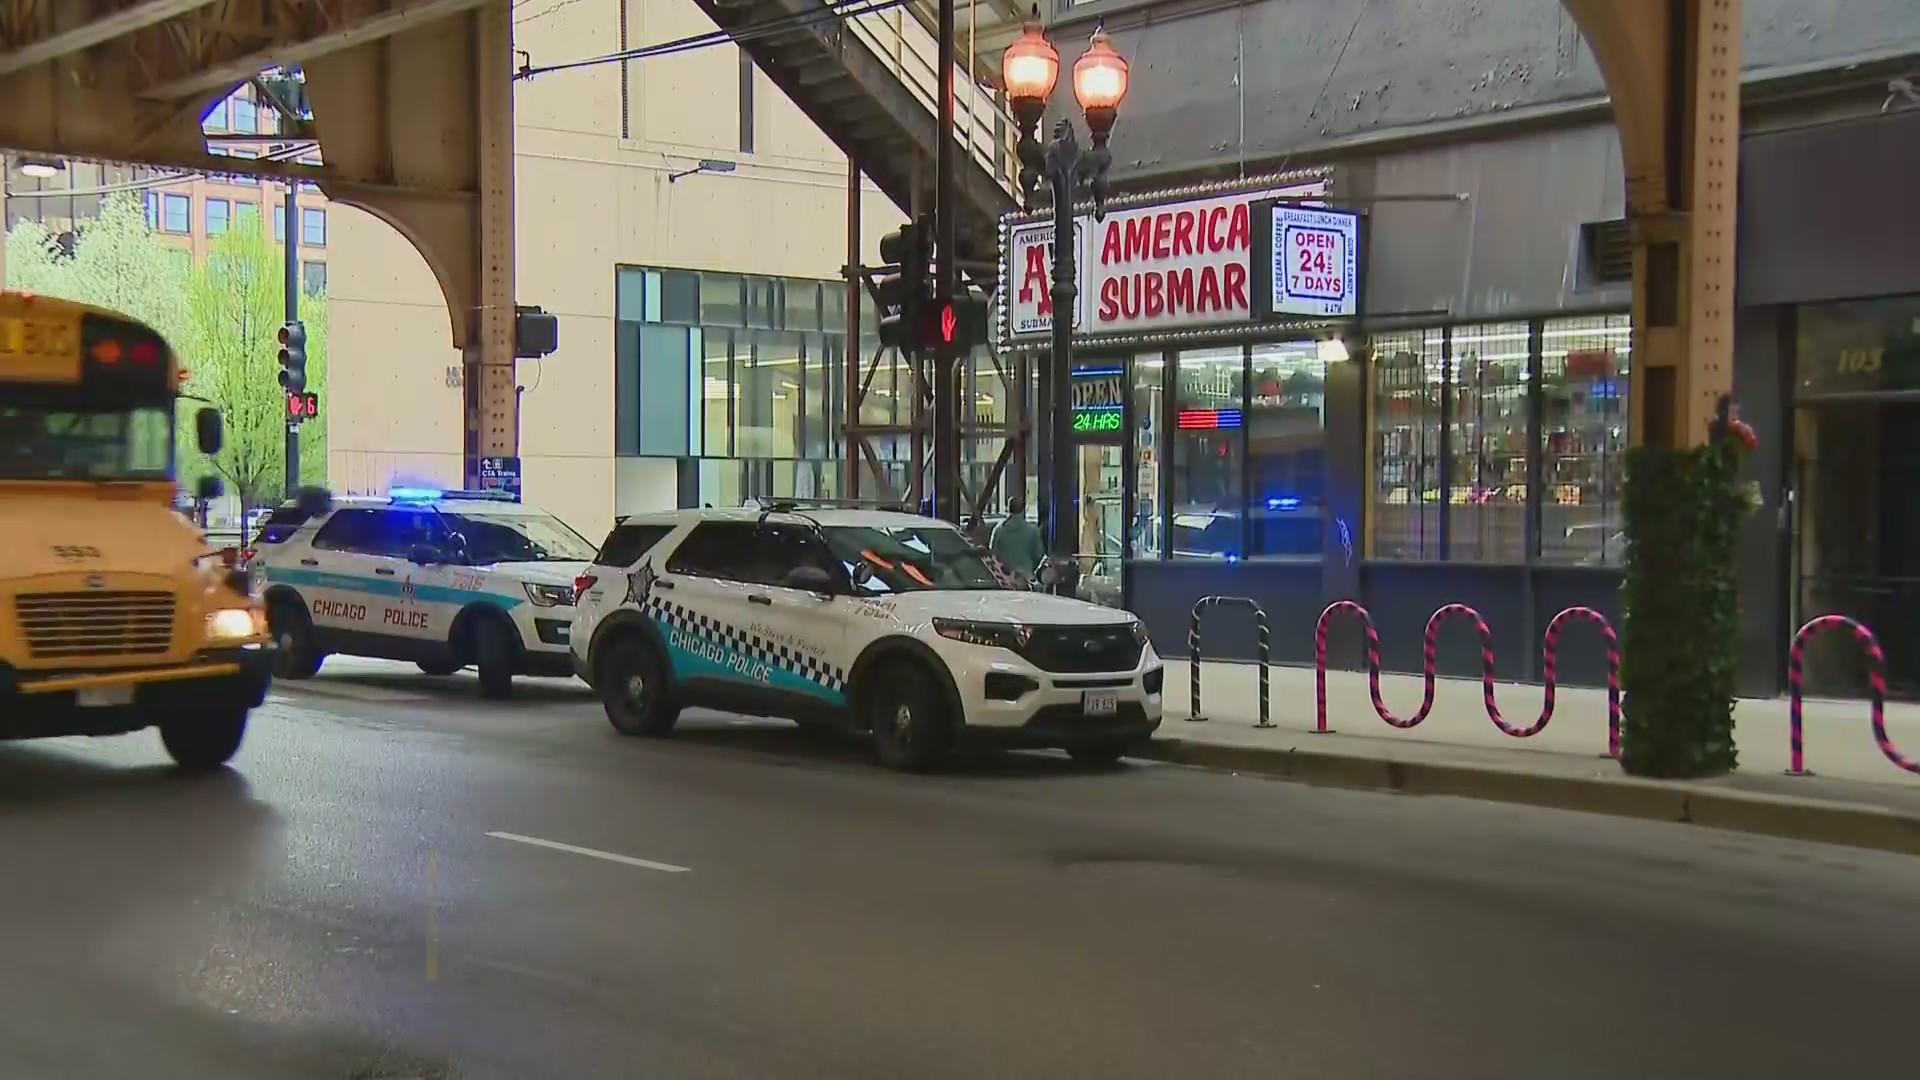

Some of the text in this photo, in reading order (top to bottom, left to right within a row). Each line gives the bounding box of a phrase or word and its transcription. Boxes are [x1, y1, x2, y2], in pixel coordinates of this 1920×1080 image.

[1284, 211, 1313, 224] BREAKFAST
[1275, 217, 1284, 248] COFFEE
[1295, 232, 1335, 249] OPEN
[1275, 258, 1283, 288] CREAM
[1299, 249, 1325, 273] 24
[1099, 263, 1249, 321] SUBMAR
[1291, 275, 1341, 292] 7 DAYS
[1276, 290, 1284, 304] ICE
[1071, 378, 1122, 408] OPEN
[307, 397, 315, 415] 6
[1073, 411, 1120, 430] 24 HRS
[313, 599, 429, 629] CHICAGO POLICE
[669, 630, 774, 683] CHICAGO POLICE
